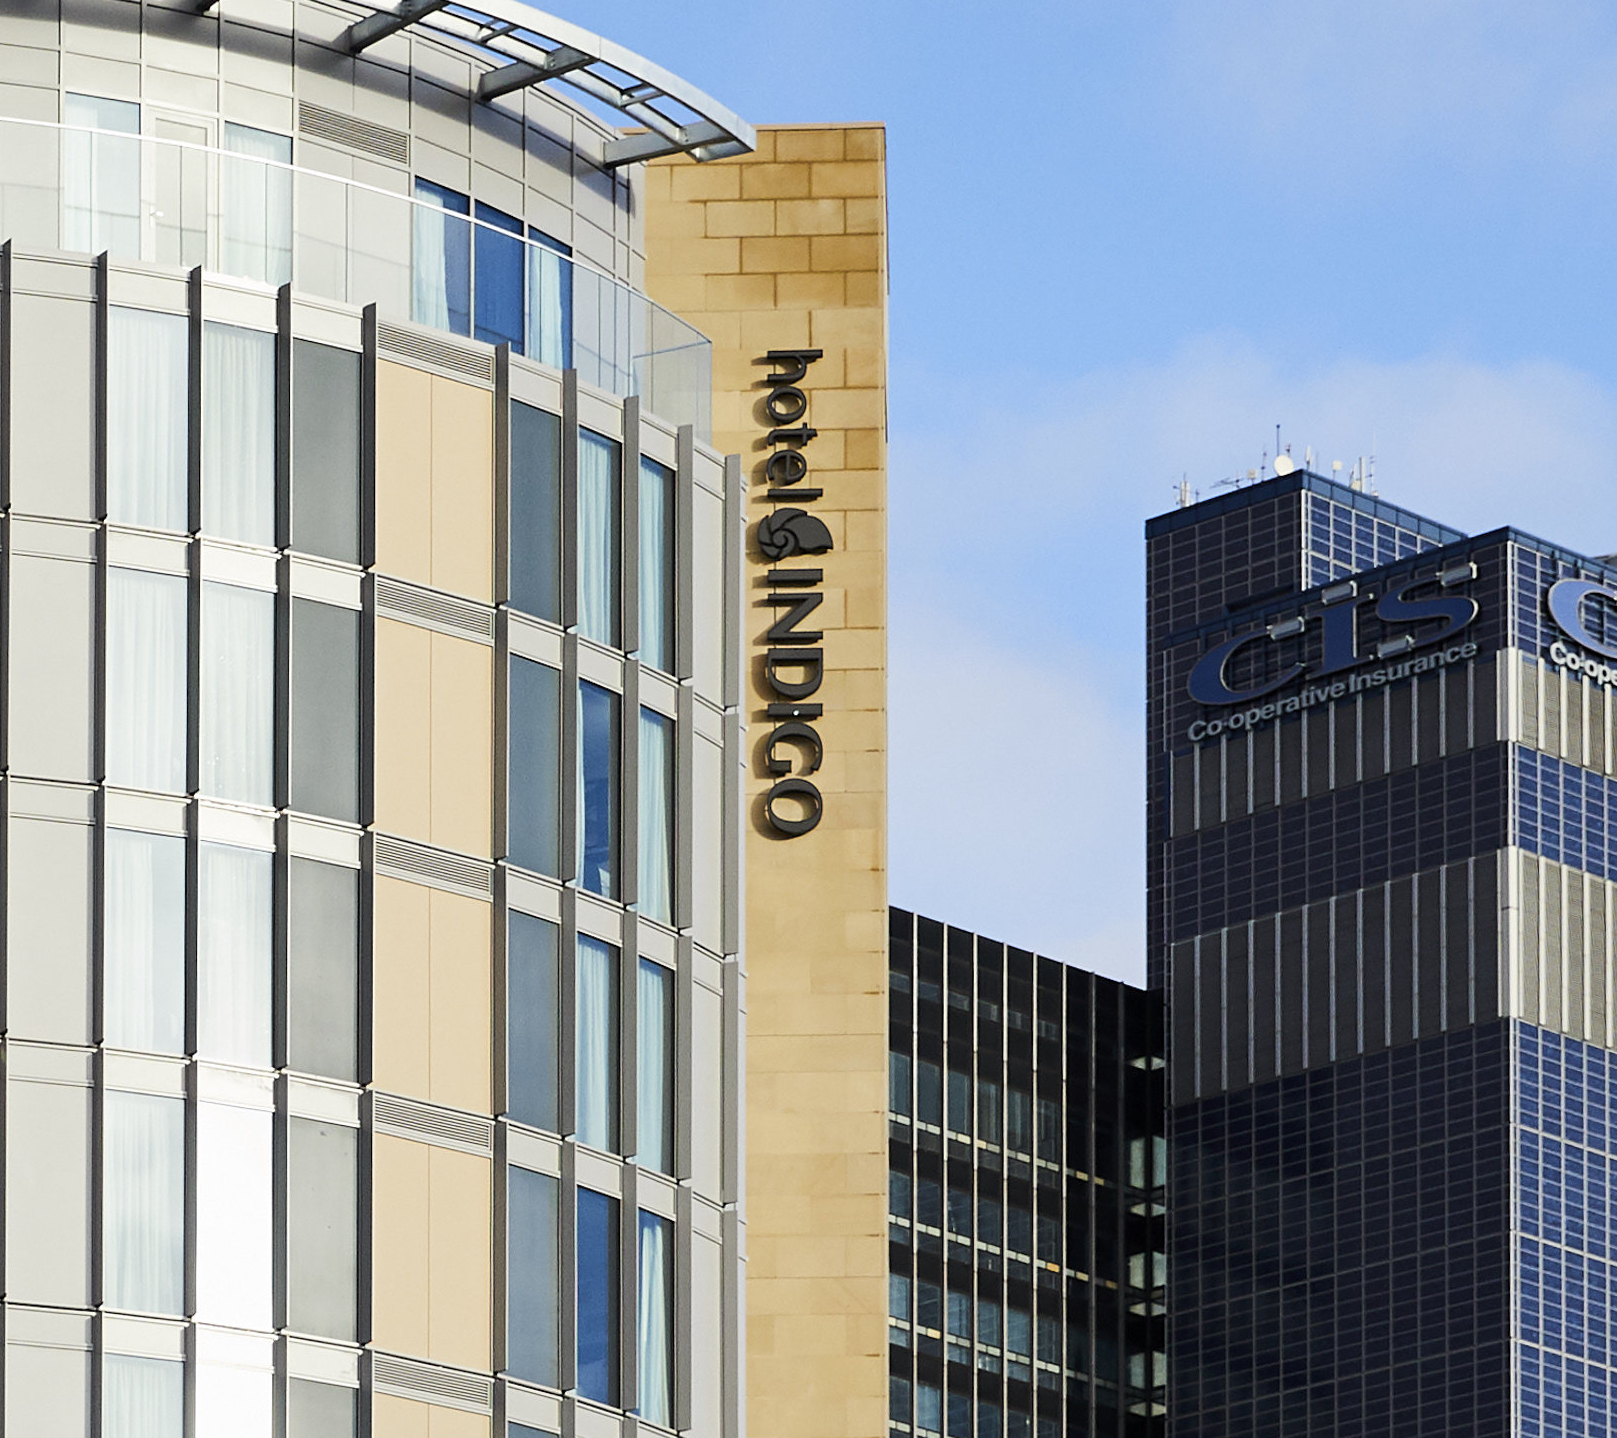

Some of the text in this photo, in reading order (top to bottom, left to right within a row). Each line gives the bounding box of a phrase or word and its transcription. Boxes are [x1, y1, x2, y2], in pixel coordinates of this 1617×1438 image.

[766, 349, 824, 838] hotel INDIGO
[1187, 572, 1479, 705] CIS
[1187, 641, 1478, 741] Co-operative Insurance
